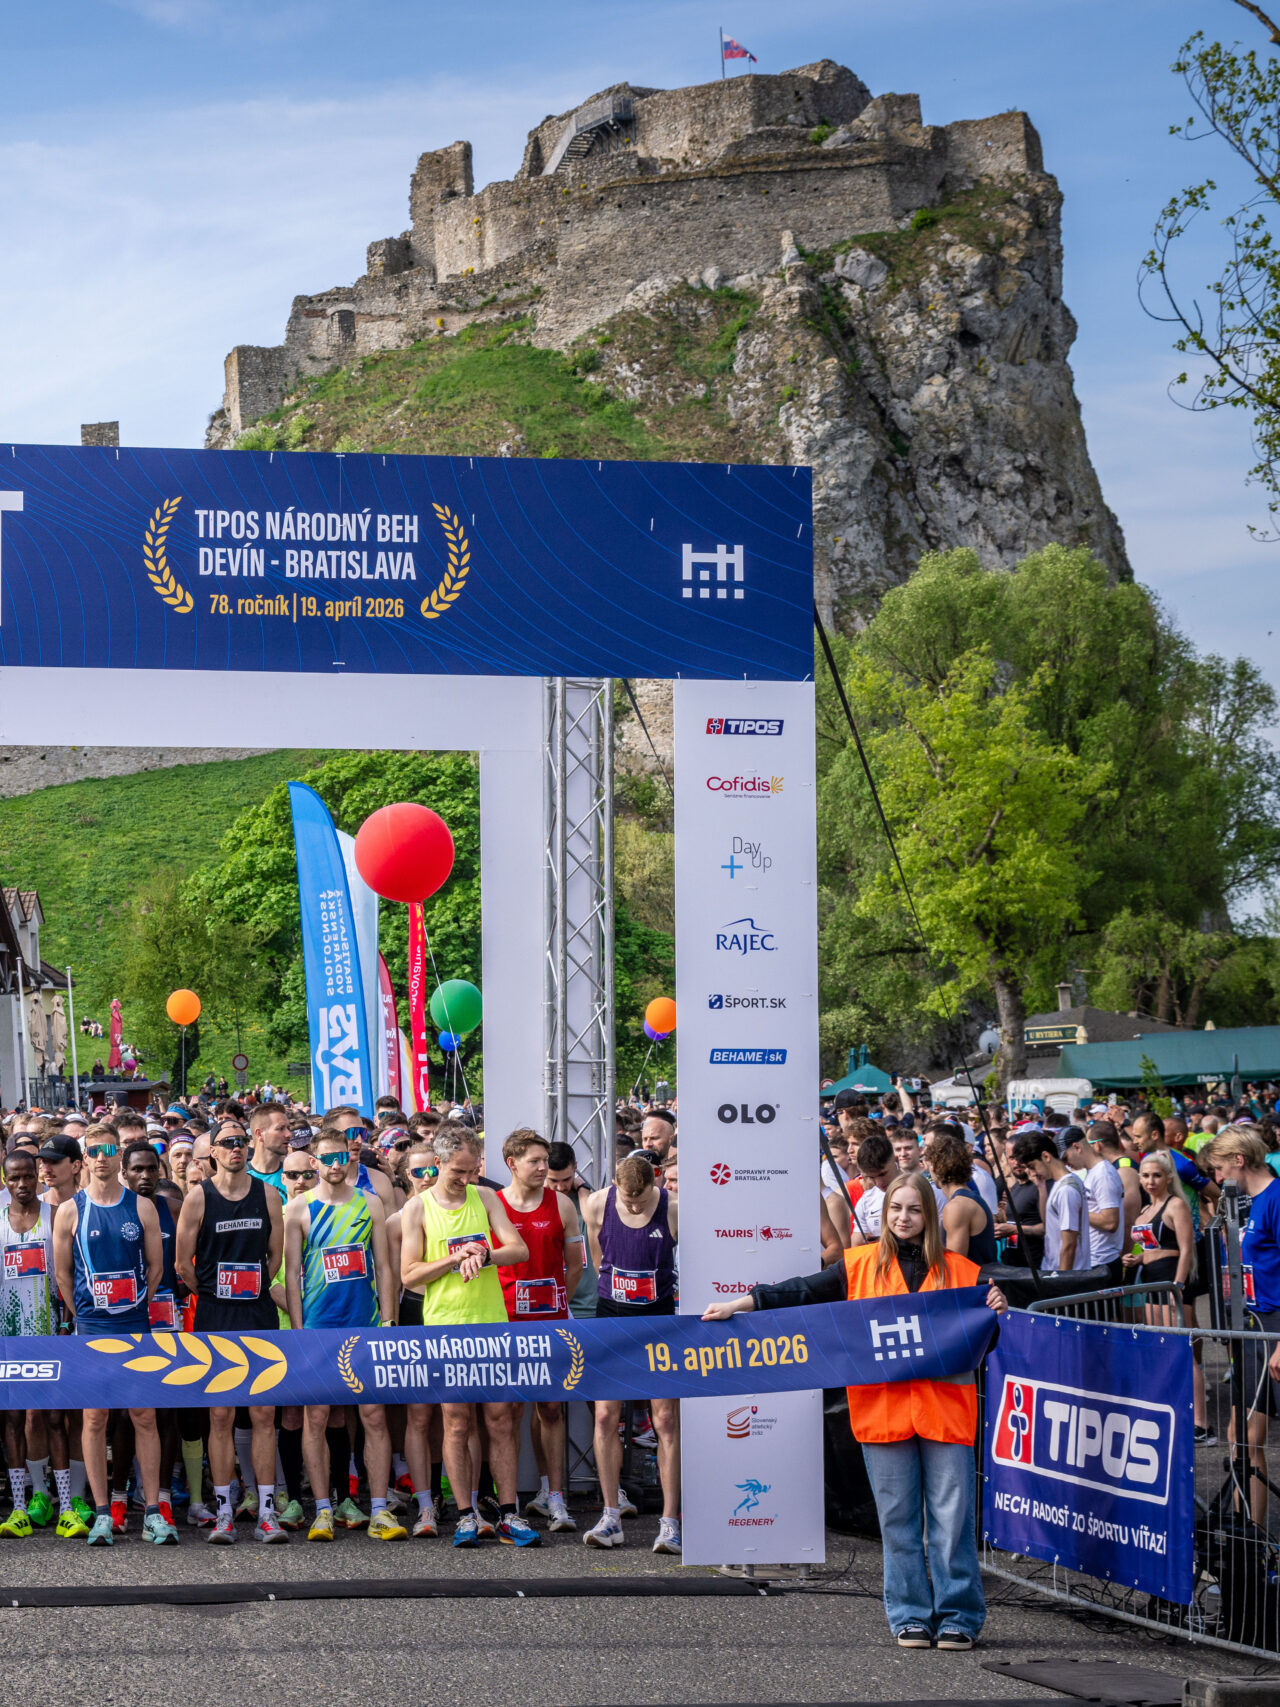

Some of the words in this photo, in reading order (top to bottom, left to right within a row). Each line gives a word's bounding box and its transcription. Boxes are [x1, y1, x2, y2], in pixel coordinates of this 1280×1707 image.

[195, 510, 259, 539] TIPOS
[266, 507, 371, 541] NÁRODNÝ
[378, 515, 418, 542] BEH
[199, 543, 264, 576] DEVÍN
[286, 550, 416, 580] BRATISLAVA
[210, 595, 233, 614] 78.
[238, 595, 289, 615] ročník
[301, 597, 320, 616] 19.
[326, 596, 361, 621] apríl
[366, 598, 404, 617] 2026
[727, 720, 781, 735] TIPOS
[706, 776, 770, 792] Cofidis
[732, 836, 761, 860] Day
[716, 934, 775, 956] RAJEC
[725, 995, 787, 1009] ŠPORT.SK
[717, 1103, 776, 1124] OLO
[714, 1229, 754, 1238] TAURIS
[5, 1250, 23, 1266] 775
[325, 1253, 349, 1268] 1130
[220, 1272, 237, 1285] 971
[614, 1278, 637, 1291] 1009
[94, 1281, 113, 1295] 902
[517, 1287, 529, 1300] 44
[367, 1340, 421, 1360] TIPOS
[425, 1333, 511, 1359] NÁRODNÝ
[516, 1336, 551, 1357] BEH
[645, 1343, 678, 1371] 19.
[684, 1338, 741, 1376] apríl
[747, 1335, 808, 1366] 2026
[374, 1361, 428, 1387] DEVÍN
[445, 1363, 551, 1386] BRATISLAVA
[1044, 1400, 1160, 1484] TIPOS
[728, 1518, 774, 1527] REGENERY
[995, 1492, 1030, 1515] NECH
[1032, 1501, 1069, 1527] RADOSŤ
[1072, 1512, 1085, 1532] ZO
[1088, 1512, 1128, 1544] ŠPORTU
[1131, 1525, 1166, 1554] VÍŤAZÍ
